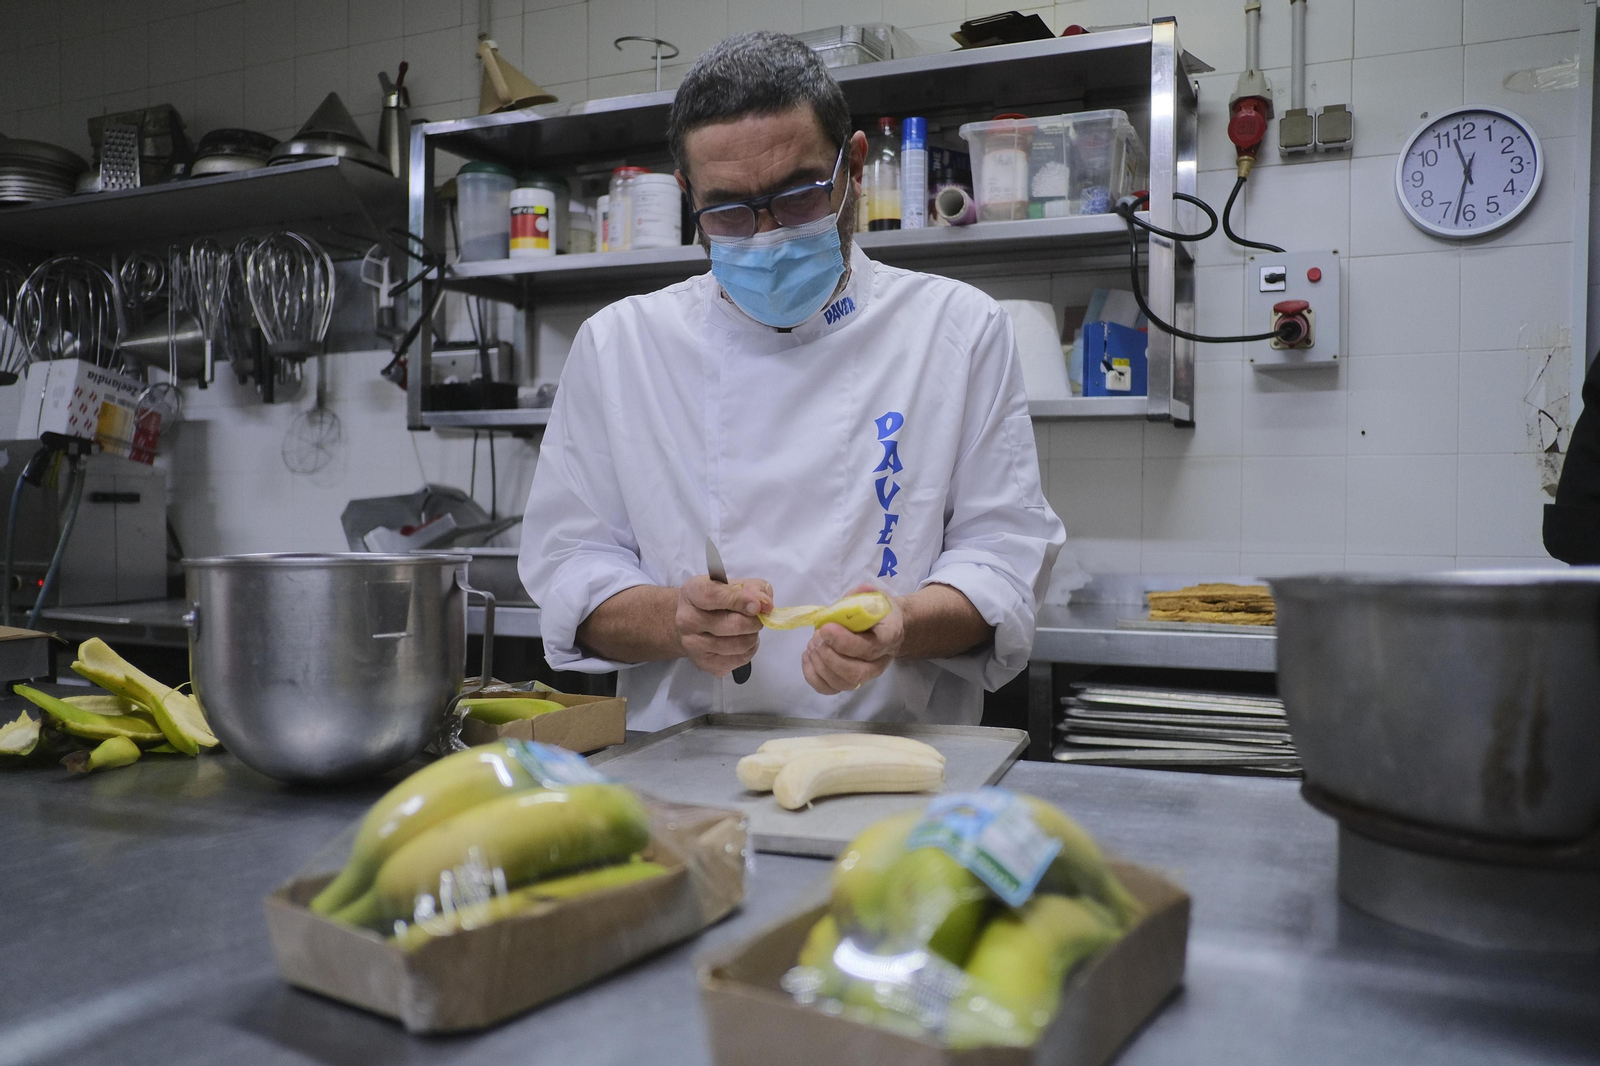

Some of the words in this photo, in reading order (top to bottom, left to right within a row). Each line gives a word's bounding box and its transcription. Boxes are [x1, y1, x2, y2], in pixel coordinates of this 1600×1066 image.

[1433, 131, 1450, 149] 11
[1453, 122, 1476, 141] 12
[1484, 125, 1492, 142] 1
[1501, 136, 1515, 154] 2
[1417, 149, 1438, 167] 10
[1510, 156, 1524, 174] 3
[1411, 171, 1424, 188] 9
[1503, 178, 1517, 195] 4
[1421, 190, 1434, 207] 8
[1486, 195, 1500, 213] 5
[1439, 201, 1452, 219] 7
[1462, 204, 1476, 221] 6
[823, 297, 856, 325] DAVER
[87, 370, 139, 397] Zeelandia
[872, 411, 904, 579] DAVER
